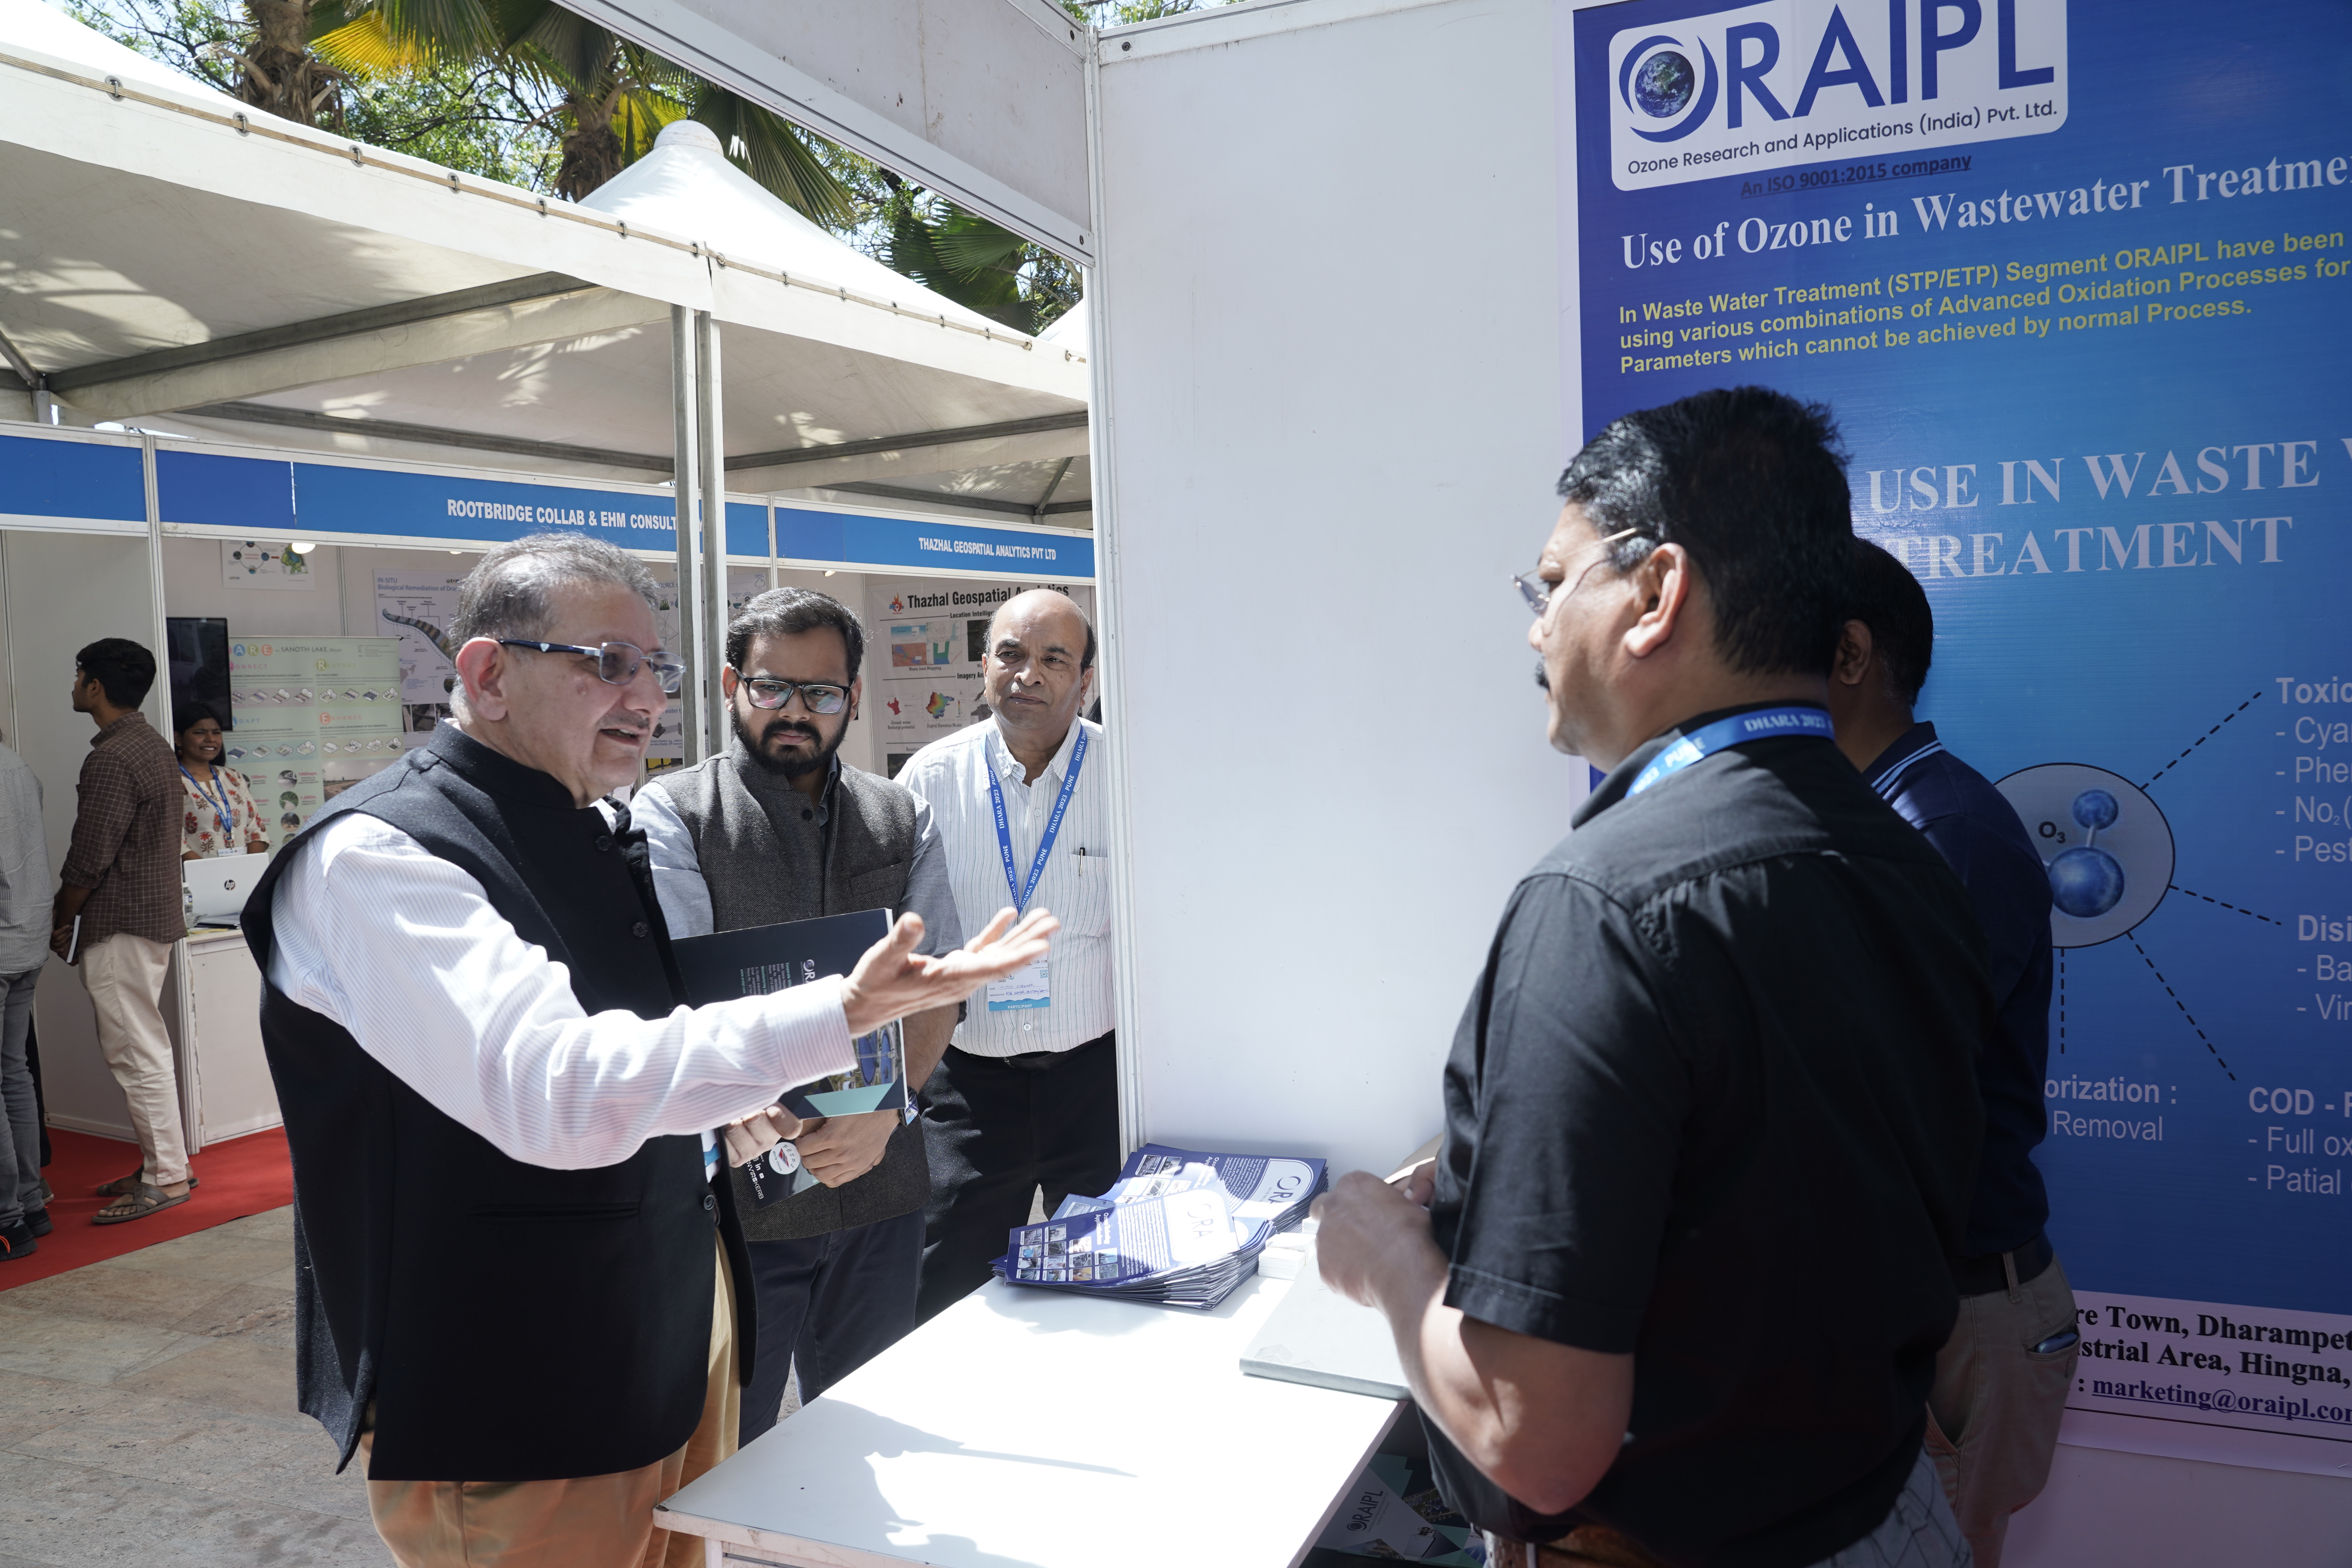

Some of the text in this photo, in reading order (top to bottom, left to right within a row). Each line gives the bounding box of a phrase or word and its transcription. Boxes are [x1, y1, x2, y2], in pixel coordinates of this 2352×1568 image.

[1619, 0, 2054, 143] ORAIPL
[1628, 100, 2057, 174] Ozone Research and Applications (India) Pvt. Ltd.
[1740, 156, 1972, 197] An ISO 9001:2015 company
[1621, 155, 2352, 269] Use of Ozone in Wastewater Treatme
[1620, 232, 2344, 323] In Waste Water Treatment (STP/ETP) Segment ORAIPL have been
[1620, 257, 2350, 348] using various combinations of Advanced Oxidation Processes for
[1621, 299, 2252, 374] Parameters which cannot be achieved by normal Process.
[1865, 464, 1979, 514] USE
[1997, 458, 2064, 506] IN
[2082, 440, 2320, 500] WASTE
[447, 499, 533, 523] ROOTBRIDGE
[536, 507, 585, 526] COLLAB
[588, 510, 597, 526] &
[601, 511, 626, 528] EHM
[918, 537, 1056, 560] THAZHAL GEOSPATIAL ANALYTICS PVT LTD
[1882, 516, 2293, 580] TREATMENT
[907, 592, 949, 608] Thazhal
[953, 587, 1011, 606] Geospatial
[1075, 739, 1085, 762] DHARA
[2295, 716, 2352, 750] Cya
[2296, 756, 2352, 783] Phe
[996, 805, 1005, 829] DHARA
[1049, 774, 1075, 834] DHARA 2023 PUNE
[1030, 867, 1040, 884] 2023
[1037, 848, 1047, 866] PUNE
[2043, 1074, 2160, 1104] orization
[2249, 1087, 2315, 1115] COD
[2053, 1110, 2163, 1141] Removal
[2267, 1126, 2314, 1154] Full
[2267, 1164, 2341, 1195] Patial
[2105, 1306, 2189, 1339] Town,
[2078, 1338, 2350, 1388] strial Area, Hingna,
[1347, 1490, 1384, 1531] ORAIPL
